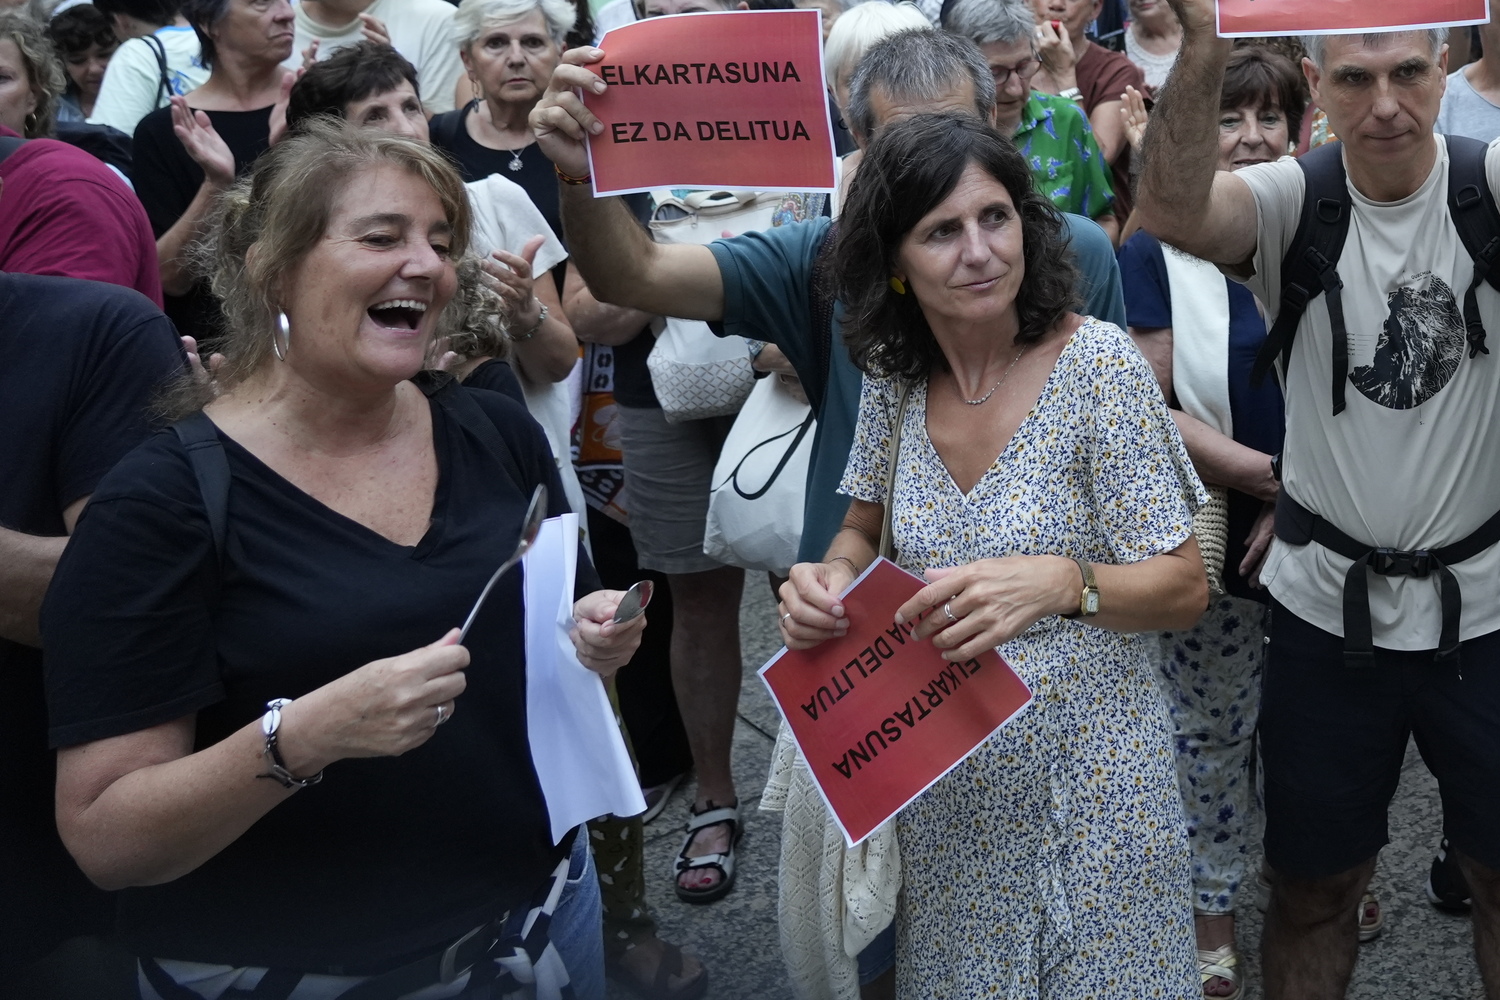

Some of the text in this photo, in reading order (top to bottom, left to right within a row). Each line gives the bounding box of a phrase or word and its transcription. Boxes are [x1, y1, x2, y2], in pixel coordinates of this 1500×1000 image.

[601, 61, 801, 86] ELKARTASUNA
[611, 120, 810, 144] EZ DA DELITUA
[801, 635, 895, 721] DELITUA
[832, 658, 981, 780] ELKARTASUNA
